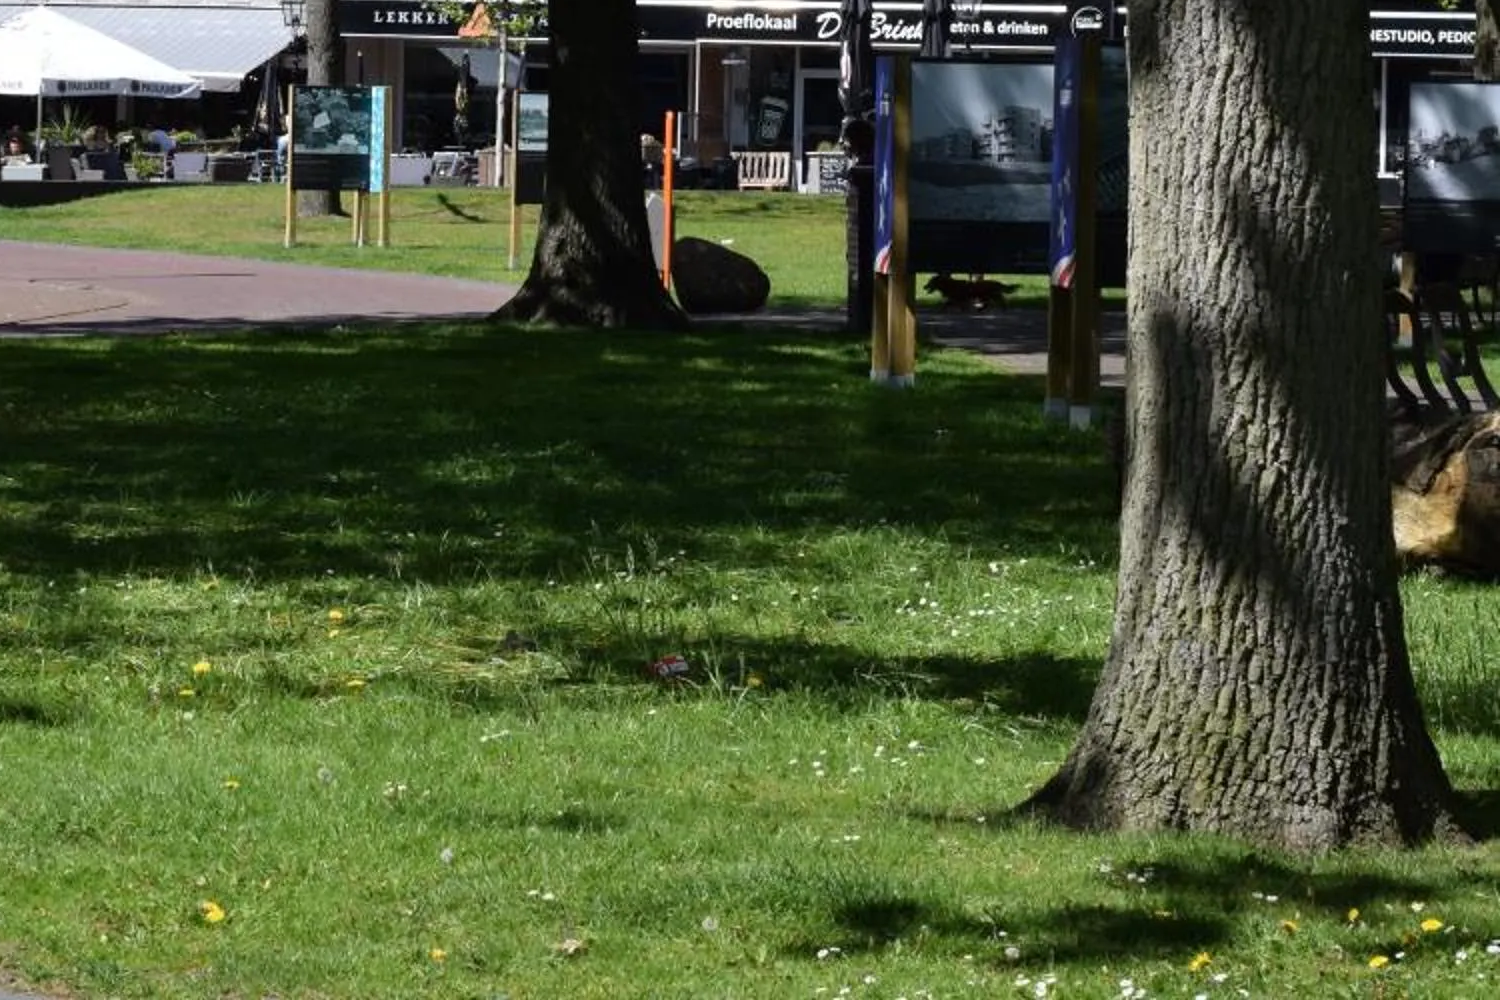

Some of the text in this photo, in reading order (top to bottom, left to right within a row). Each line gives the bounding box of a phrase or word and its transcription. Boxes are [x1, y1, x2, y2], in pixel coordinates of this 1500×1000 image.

[374, 11, 449, 24] LEKKER
[707, 13, 797, 30] Proeflokaal
[982, 21, 995, 34] &
[997, 20, 1049, 36] drinken
